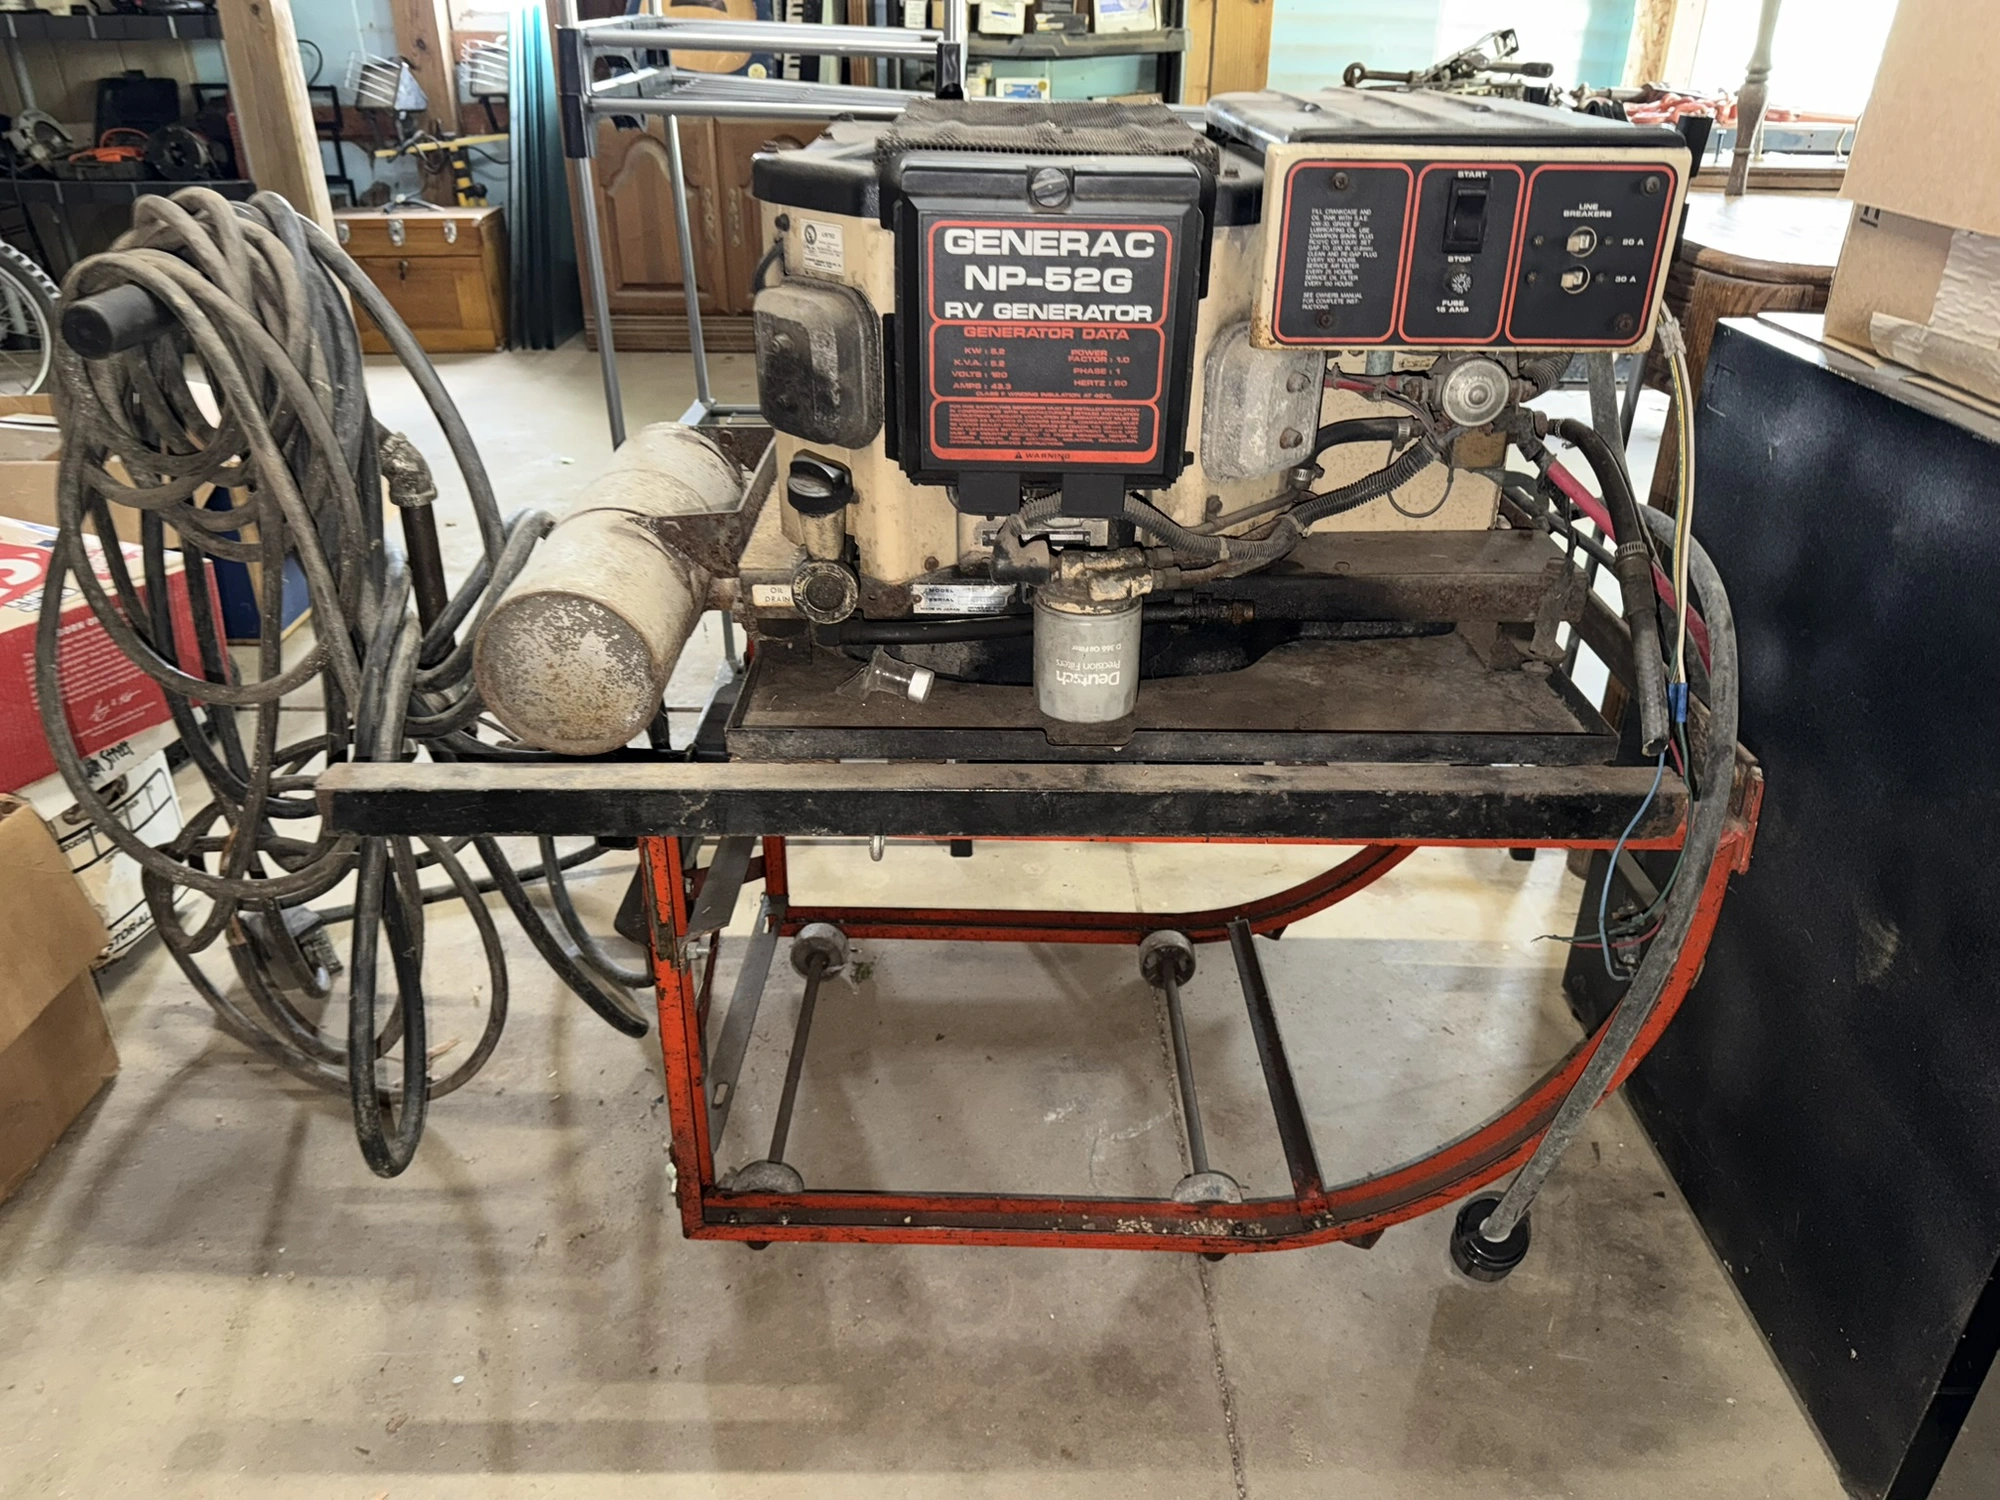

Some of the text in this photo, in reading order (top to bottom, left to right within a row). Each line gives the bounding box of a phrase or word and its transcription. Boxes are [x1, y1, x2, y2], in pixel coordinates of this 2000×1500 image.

[944, 229, 1155, 258] GENERAC
[964, 265, 1133, 293] NP-52G
[944, 302, 1152, 322] RV GENERATOR
[964, 326, 1129, 340] GENERATOR DATA
[1056, 659, 1120, 671] Precision Filters
[1056, 670, 1120, 686] Deutsch
